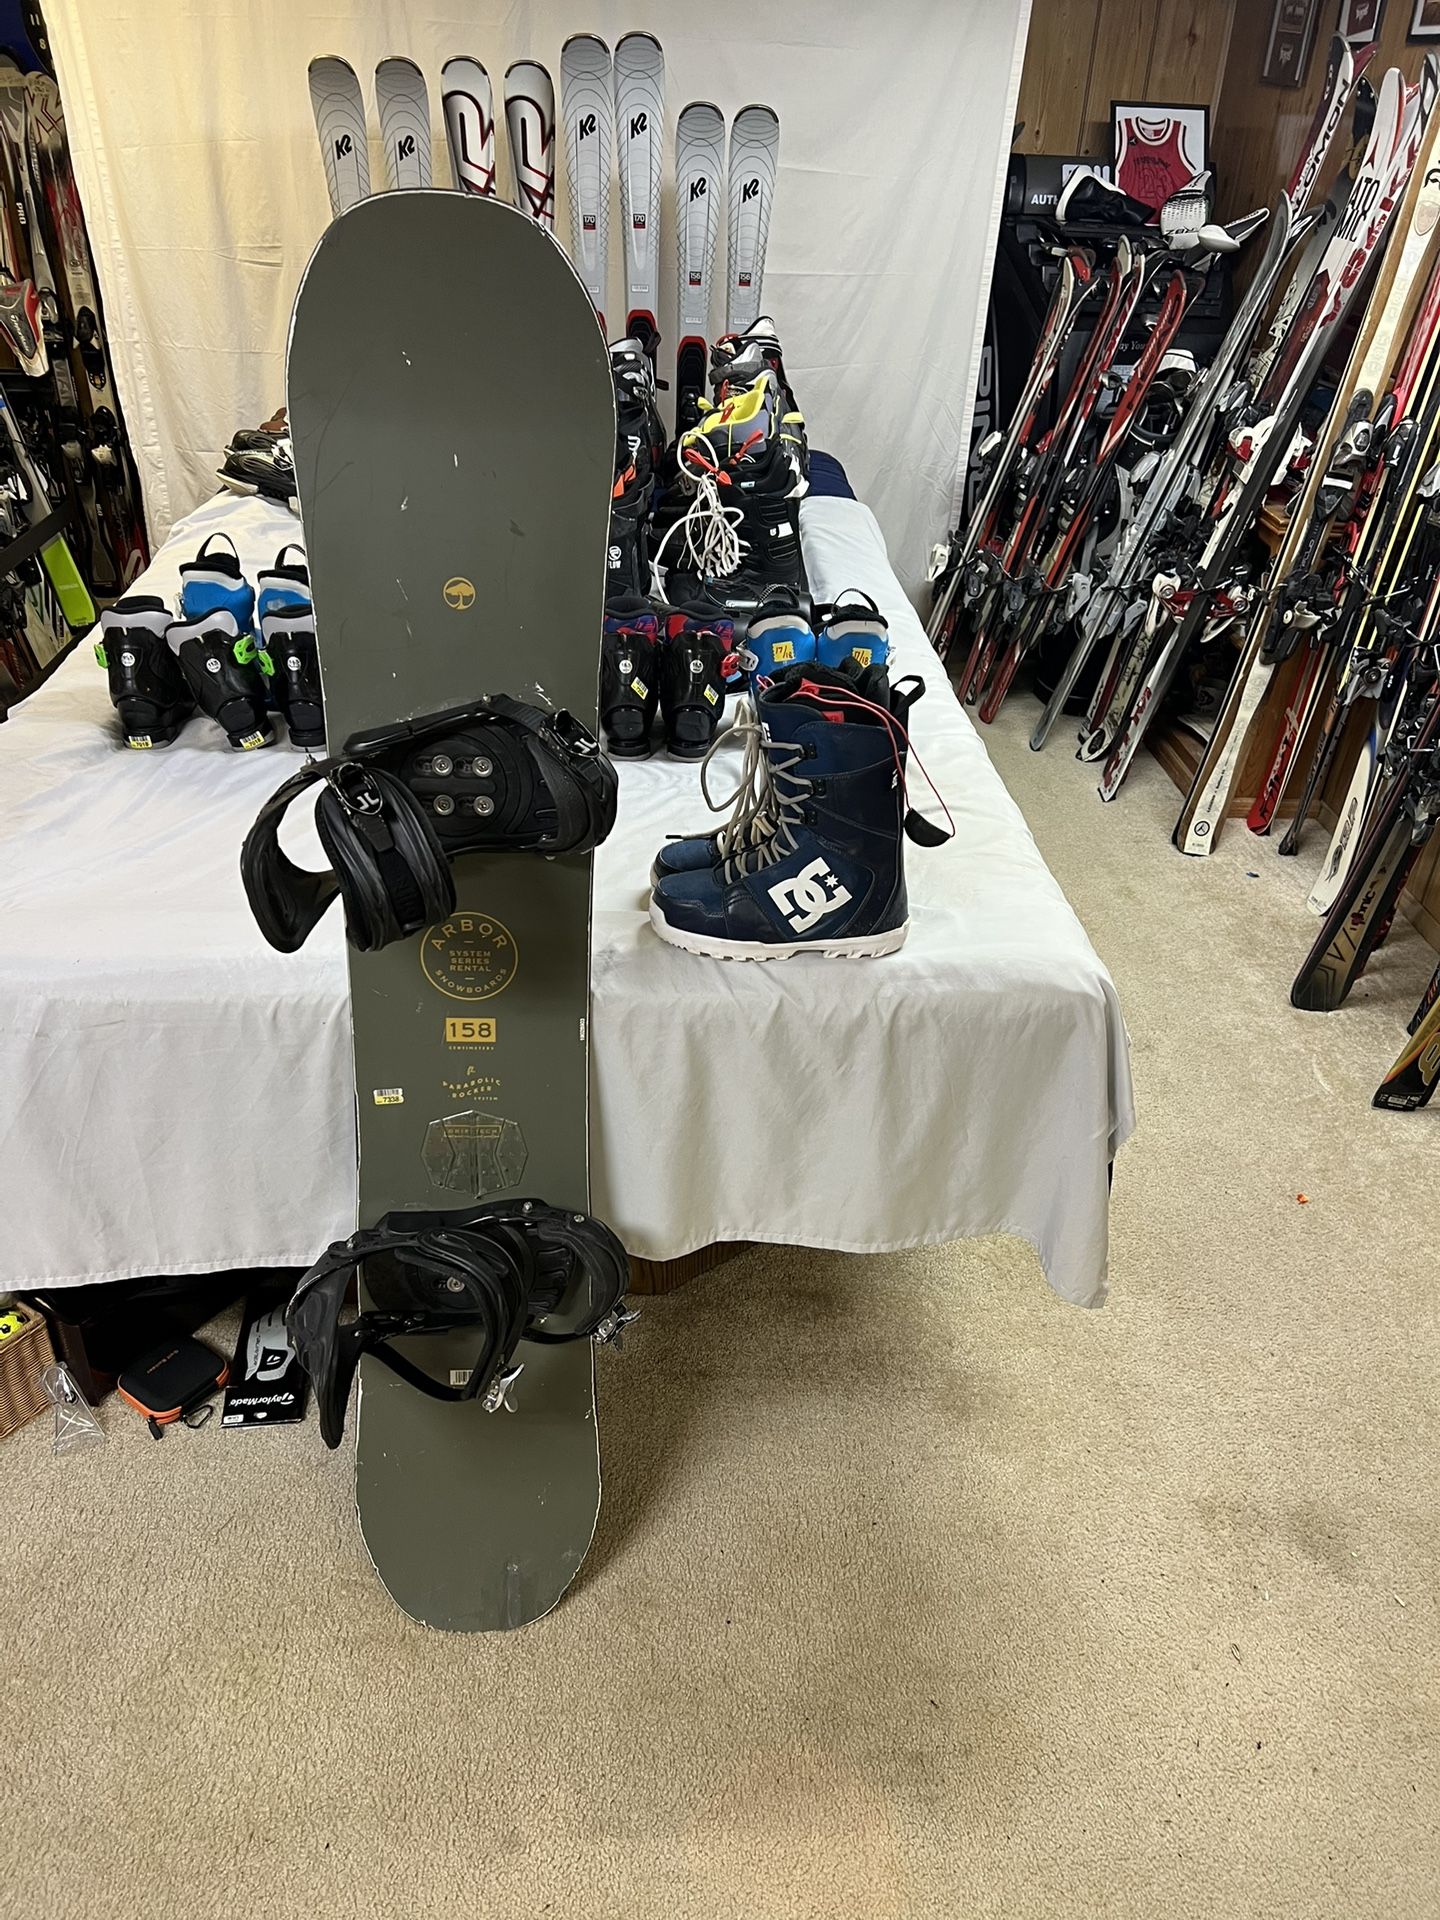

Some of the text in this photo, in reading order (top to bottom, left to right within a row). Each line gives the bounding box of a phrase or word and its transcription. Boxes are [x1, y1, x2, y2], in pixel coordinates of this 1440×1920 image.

[579, 112, 597, 141] K2
[630, 111, 648, 140] K2
[335, 133, 353, 161] K2
[398, 134, 416, 162] K2
[690, 176, 708, 203] K2
[742, 177, 760, 204] K2
[584, 214, 596, 223] 170
[634, 214, 646, 223] 170
[431, 919, 508, 951] ARBOR
[435, 968, 507, 994] SNOWBOARDS
[449, 1023, 492, 1038] 158
[229, 1392, 295, 1407] TaylorMade
